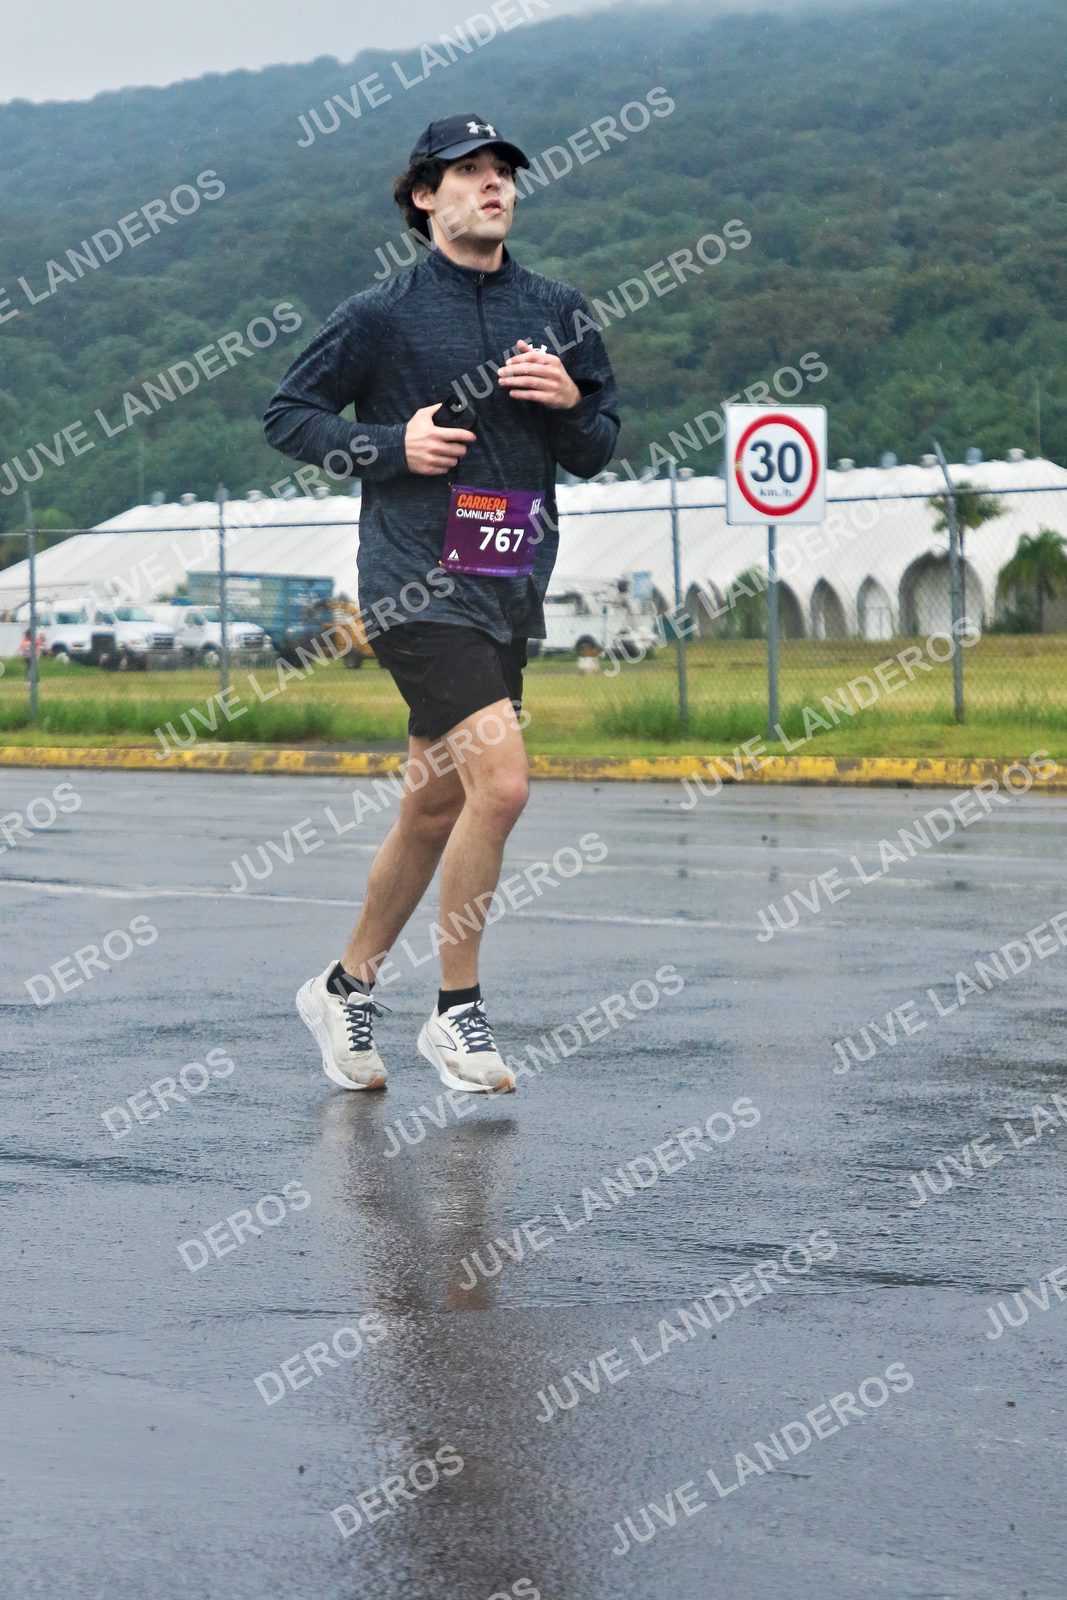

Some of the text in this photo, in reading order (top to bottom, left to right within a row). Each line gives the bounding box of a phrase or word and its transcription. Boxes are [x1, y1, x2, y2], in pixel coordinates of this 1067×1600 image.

[750, 440, 803, 484] 30
[457, 493, 508, 512] CARRERA
[456, 508, 495, 520] OMNILIFE
[480, 526, 525, 552] 767
